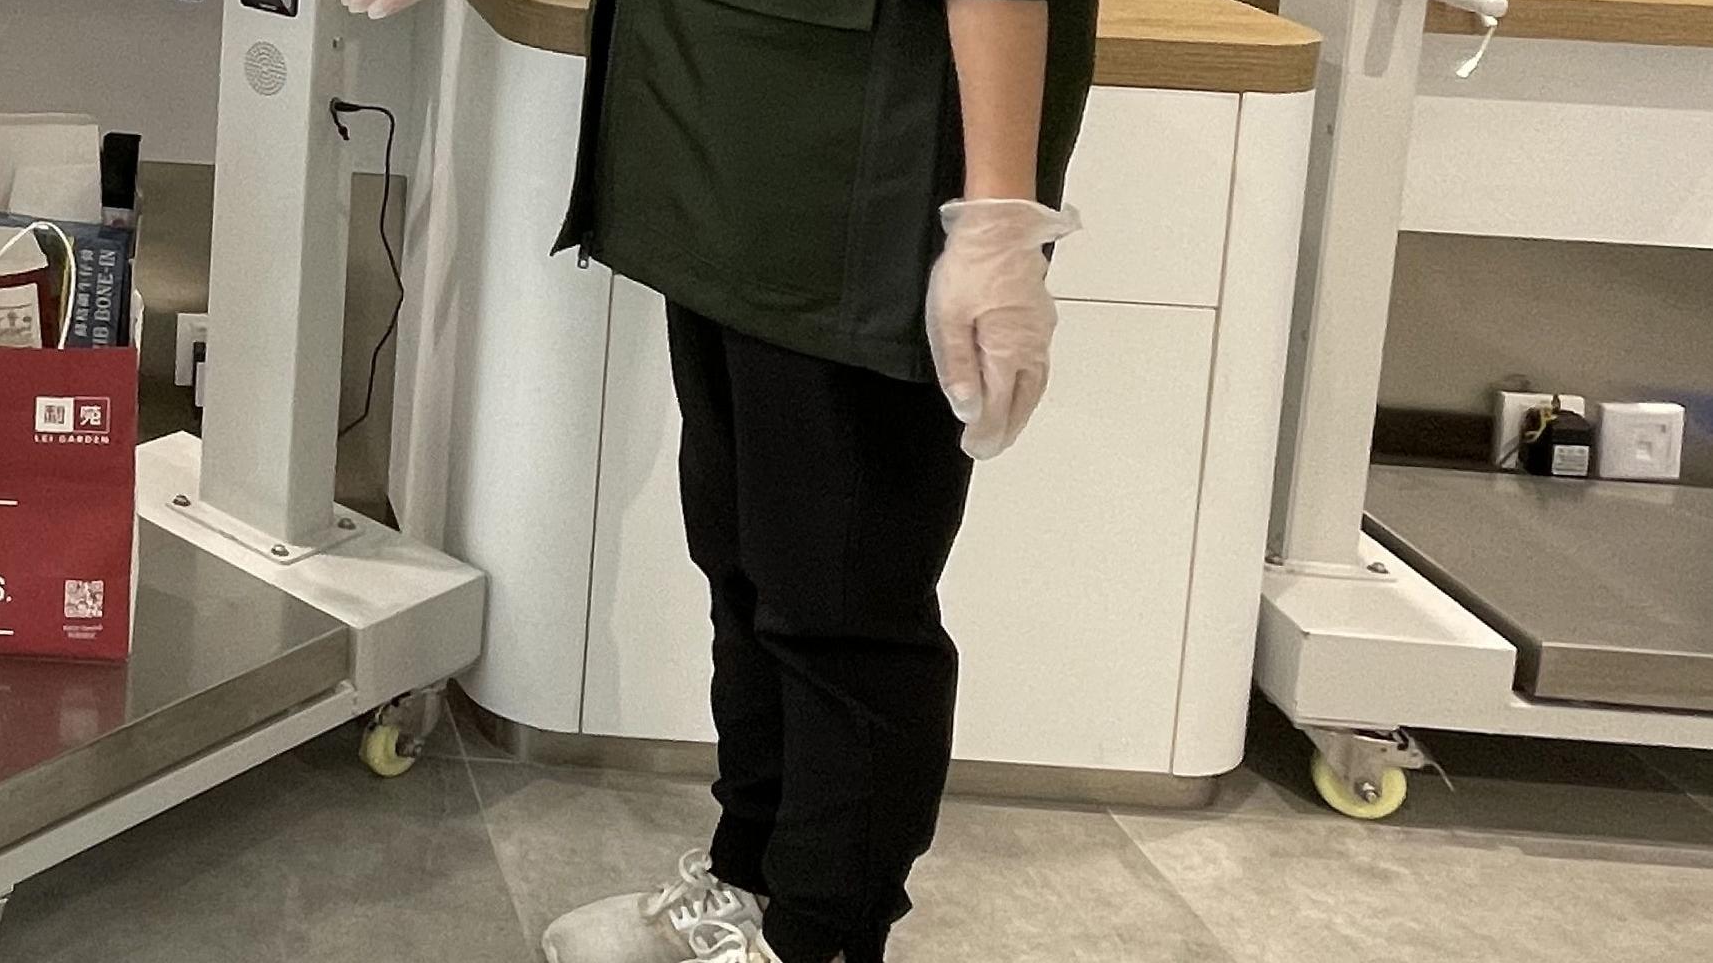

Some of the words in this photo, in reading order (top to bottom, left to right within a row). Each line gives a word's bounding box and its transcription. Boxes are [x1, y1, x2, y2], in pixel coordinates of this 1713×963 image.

[94, 248, 117, 322] BONE-IN
[34, 434, 54, 443] LEI
[58, 434, 110, 444] GARDEN
